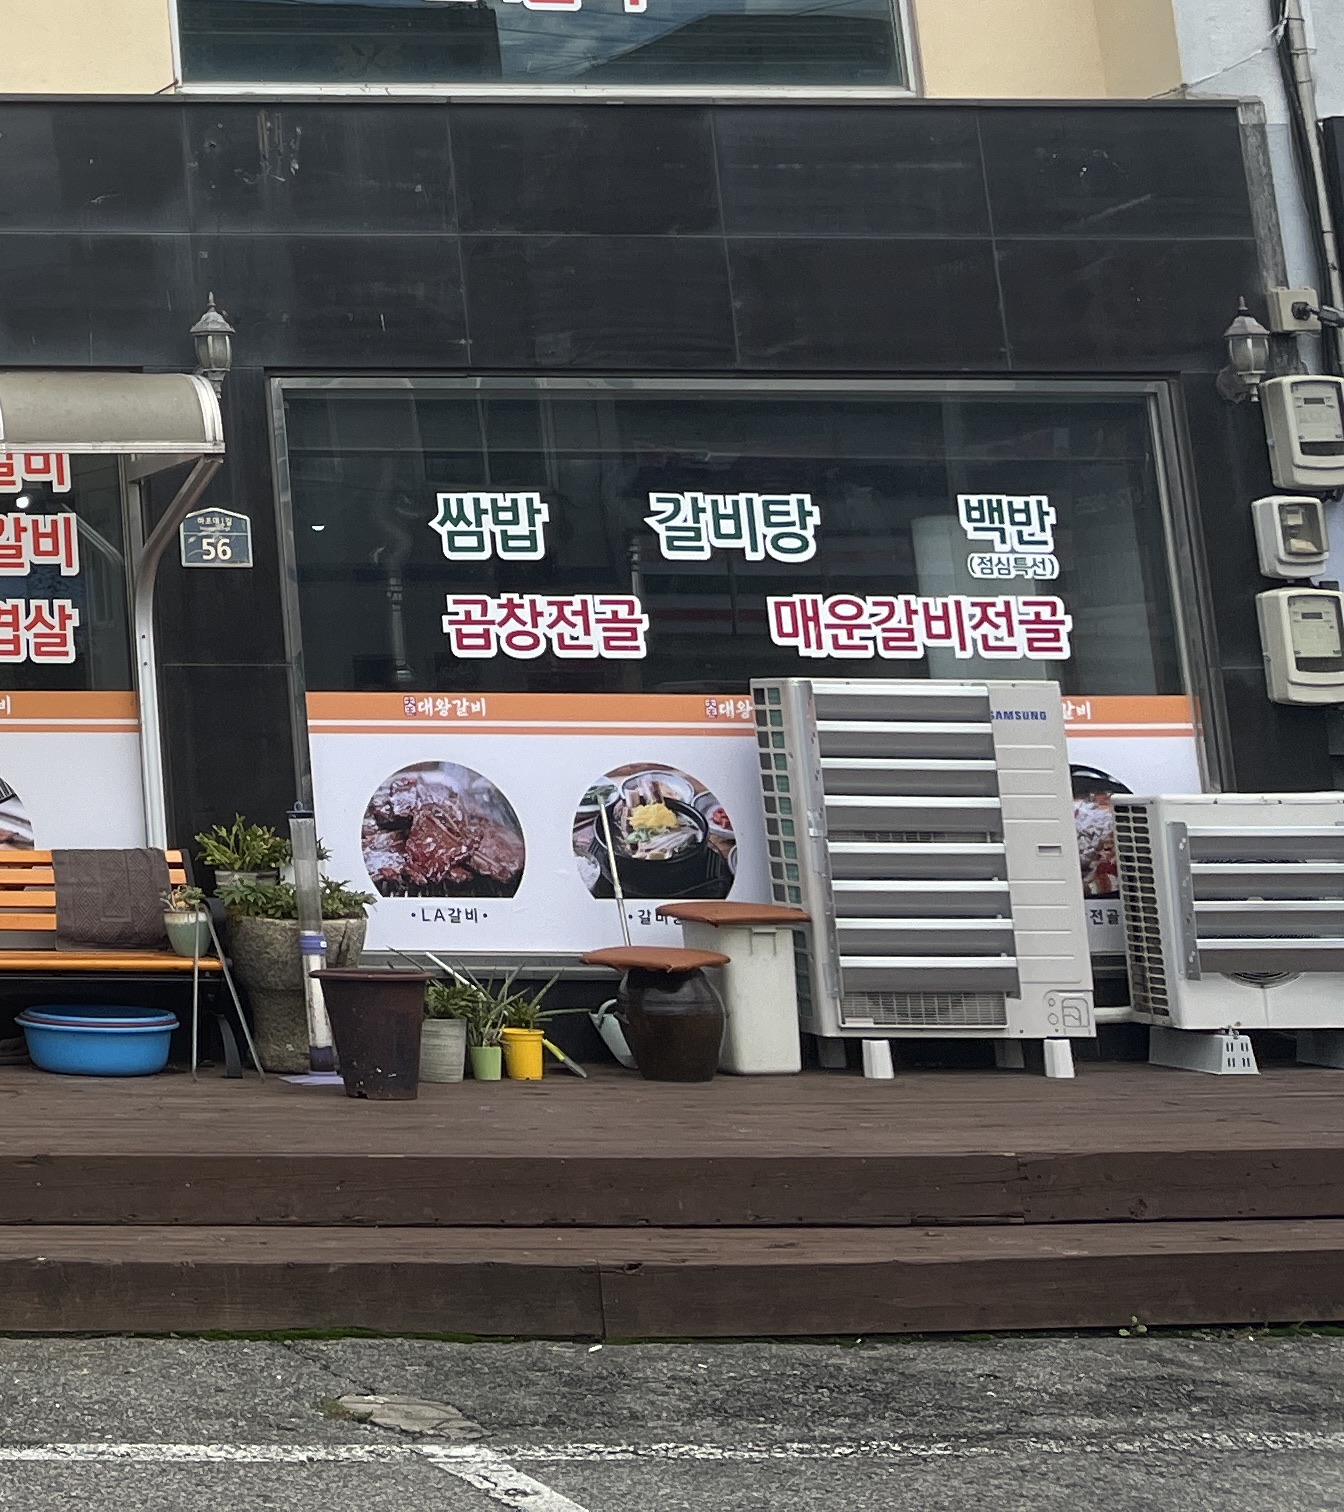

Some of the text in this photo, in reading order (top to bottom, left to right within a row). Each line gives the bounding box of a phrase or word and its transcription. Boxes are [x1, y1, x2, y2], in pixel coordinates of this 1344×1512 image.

[435, 495, 1052, 558] 쌈밥 갈비탕 백반
[202, 538, 232, 561] 56
[969, 555, 1055, 577] (점심특선)
[446, 595, 1068, 655] 곱창전골 매운갈비전골
[417, 696, 486, 718] 대왕갈비
[420, 907, 479, 924] LA갈비
[637, 909, 682, 925] 갈비
